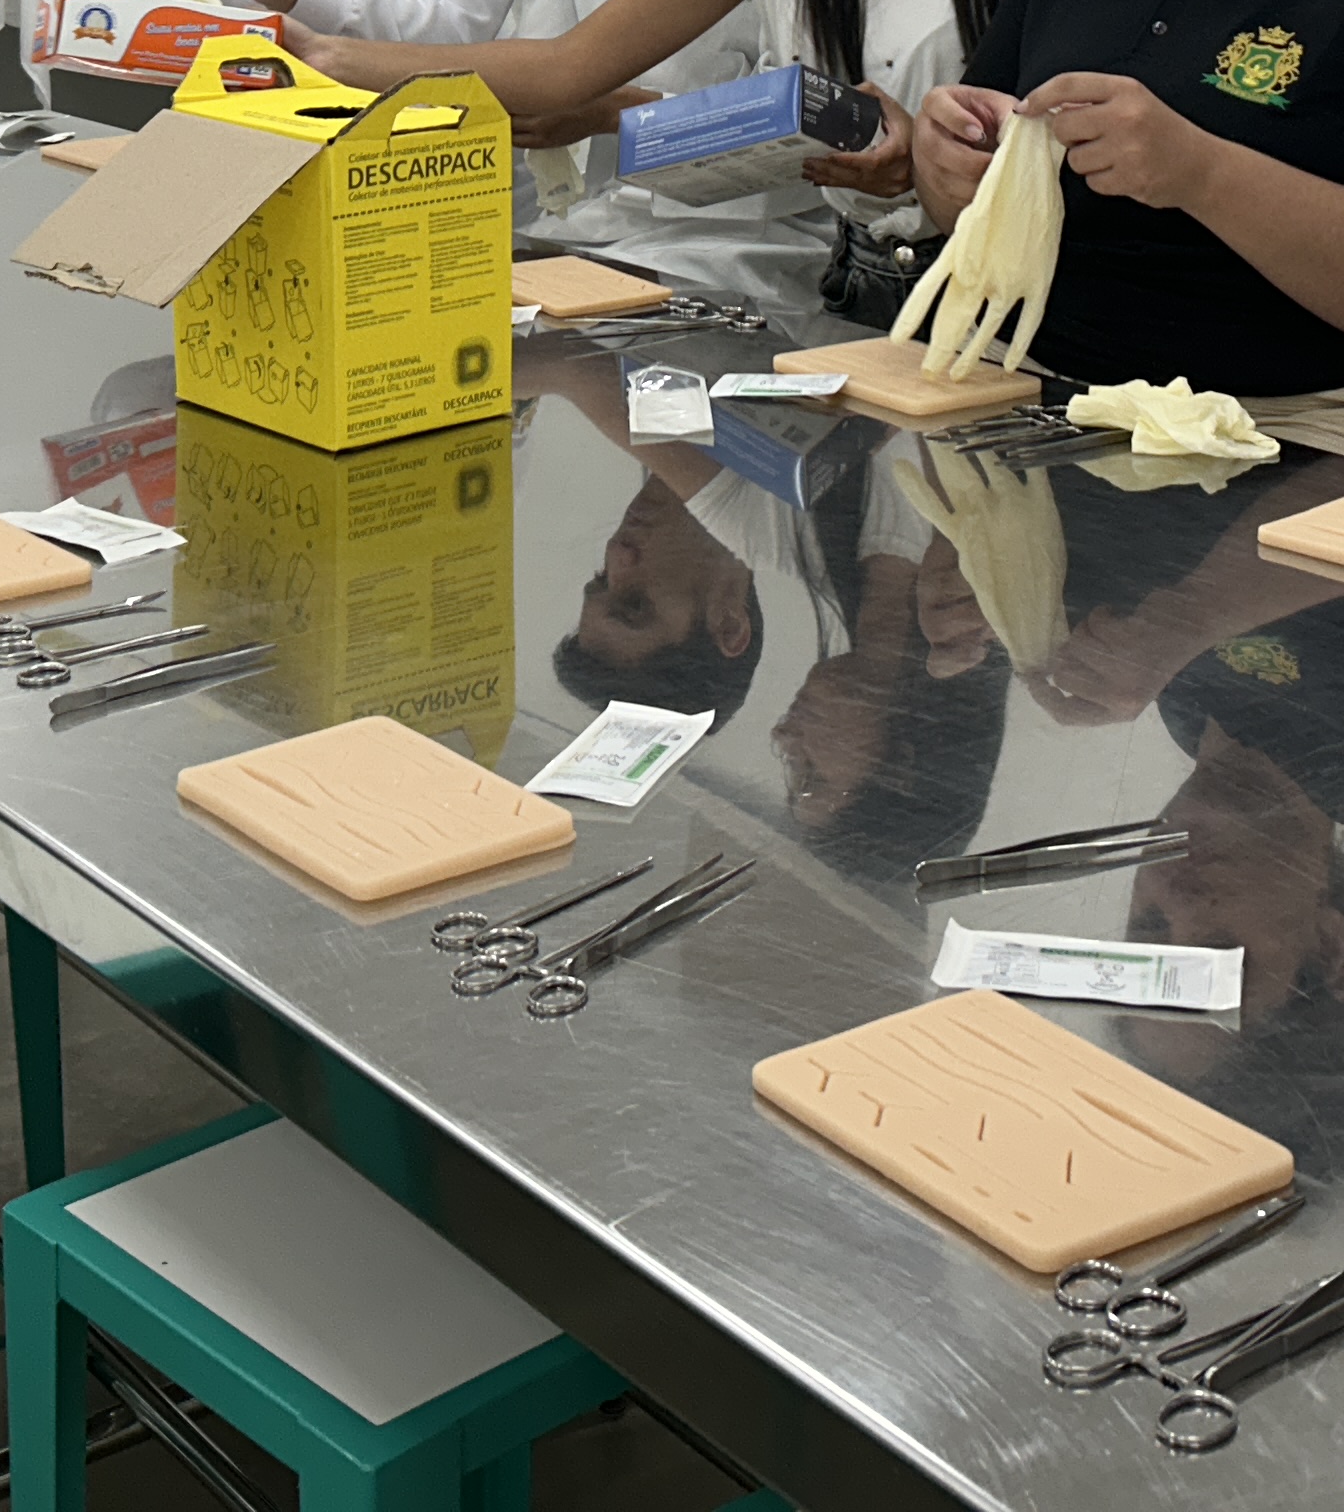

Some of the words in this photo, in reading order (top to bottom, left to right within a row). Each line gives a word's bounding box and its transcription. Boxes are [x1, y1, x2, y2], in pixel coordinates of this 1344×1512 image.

[348, 146, 496, 190] DESCARPACK
[347, 361, 387, 378] CAPACIDADE
[389, 354, 421, 368] NOMINAL
[352, 376, 375, 390] LITROS
[386, 363, 436, 383] QUILOGRAMAS
[347, 386, 385, 402] CAPACIDADE
[443, 388, 503, 411] DESCARPACK
[347, 416, 383, 433] RECIPIENTE
[383, 407, 428, 425] DESCARTÁVEL
